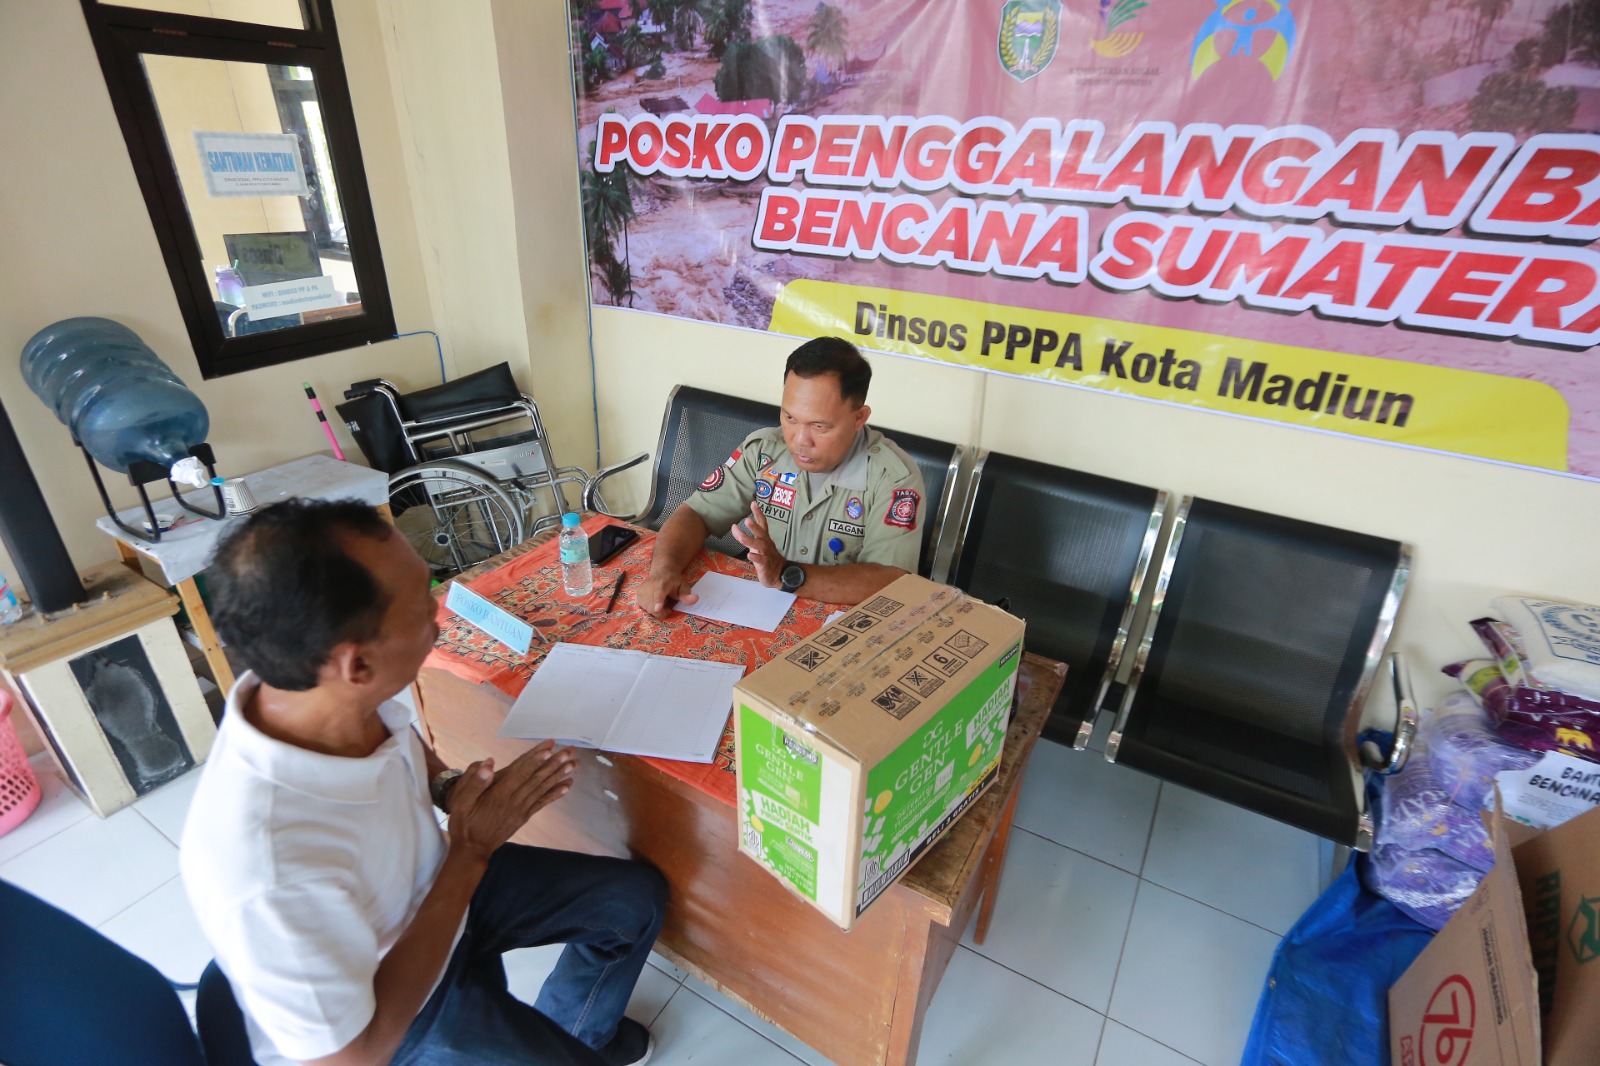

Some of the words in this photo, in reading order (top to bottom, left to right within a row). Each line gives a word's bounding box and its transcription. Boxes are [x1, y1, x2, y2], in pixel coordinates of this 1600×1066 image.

[600, 120, 764, 172] POSKO
[776, 123, 1498, 217] PENGGALANGAN
[759, 194, 1078, 273] BENCANA
[854, 301, 967, 352] Dinsos
[980, 321, 1083, 372] PPPA
[1100, 338, 1202, 391] Kota
[1217, 357, 1416, 428] Madiun
[482, 609, 524, 640] BANTUAN
[932, 653, 949, 664] 6
[973, 678, 1010, 730] HADIAH
[755, 743, 804, 782] GENTLE
[766, 761, 792, 784] GEN
[895, 718, 963, 791] GENTLE
[910, 750, 947, 794] GEN
[1529, 774, 1600, 805] BENCANA
[1561, 767, 1600, 787] BANT
[761, 796, 810, 834] HADIAH
